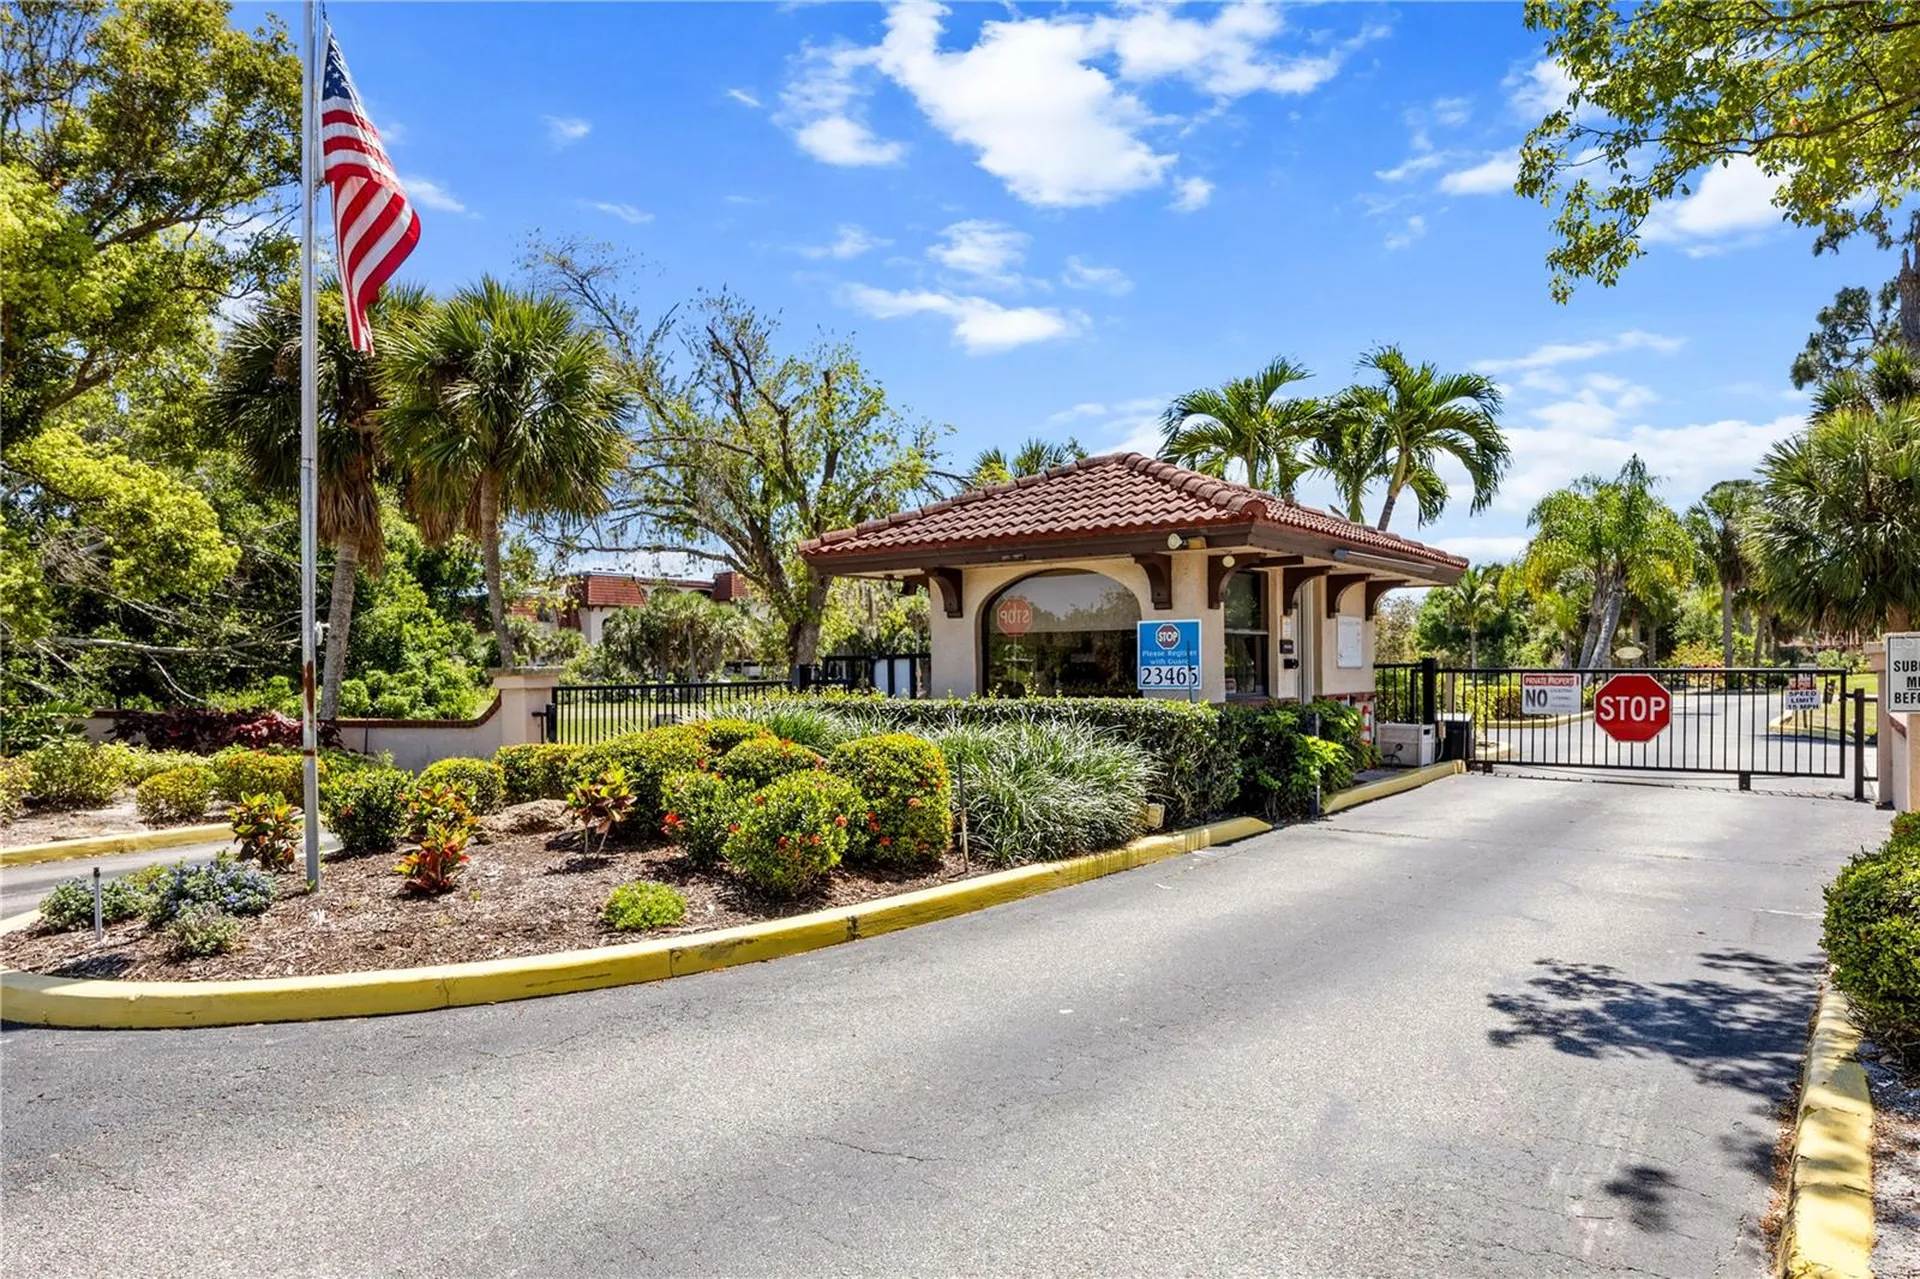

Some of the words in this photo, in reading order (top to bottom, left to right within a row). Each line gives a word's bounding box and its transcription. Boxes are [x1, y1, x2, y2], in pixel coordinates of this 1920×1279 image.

[1158, 631, 1178, 642] STOP
[1142, 650, 1165, 658] Please
[1167, 650, 1197, 658] Regiser
[1893, 660, 1920, 673] SUB
[1142, 667, 1198, 685] 23465
[1525, 677, 1547, 686] PRIVATE
[1525, 689, 1548, 707] NO
[1600, 696, 1666, 721] STOP
